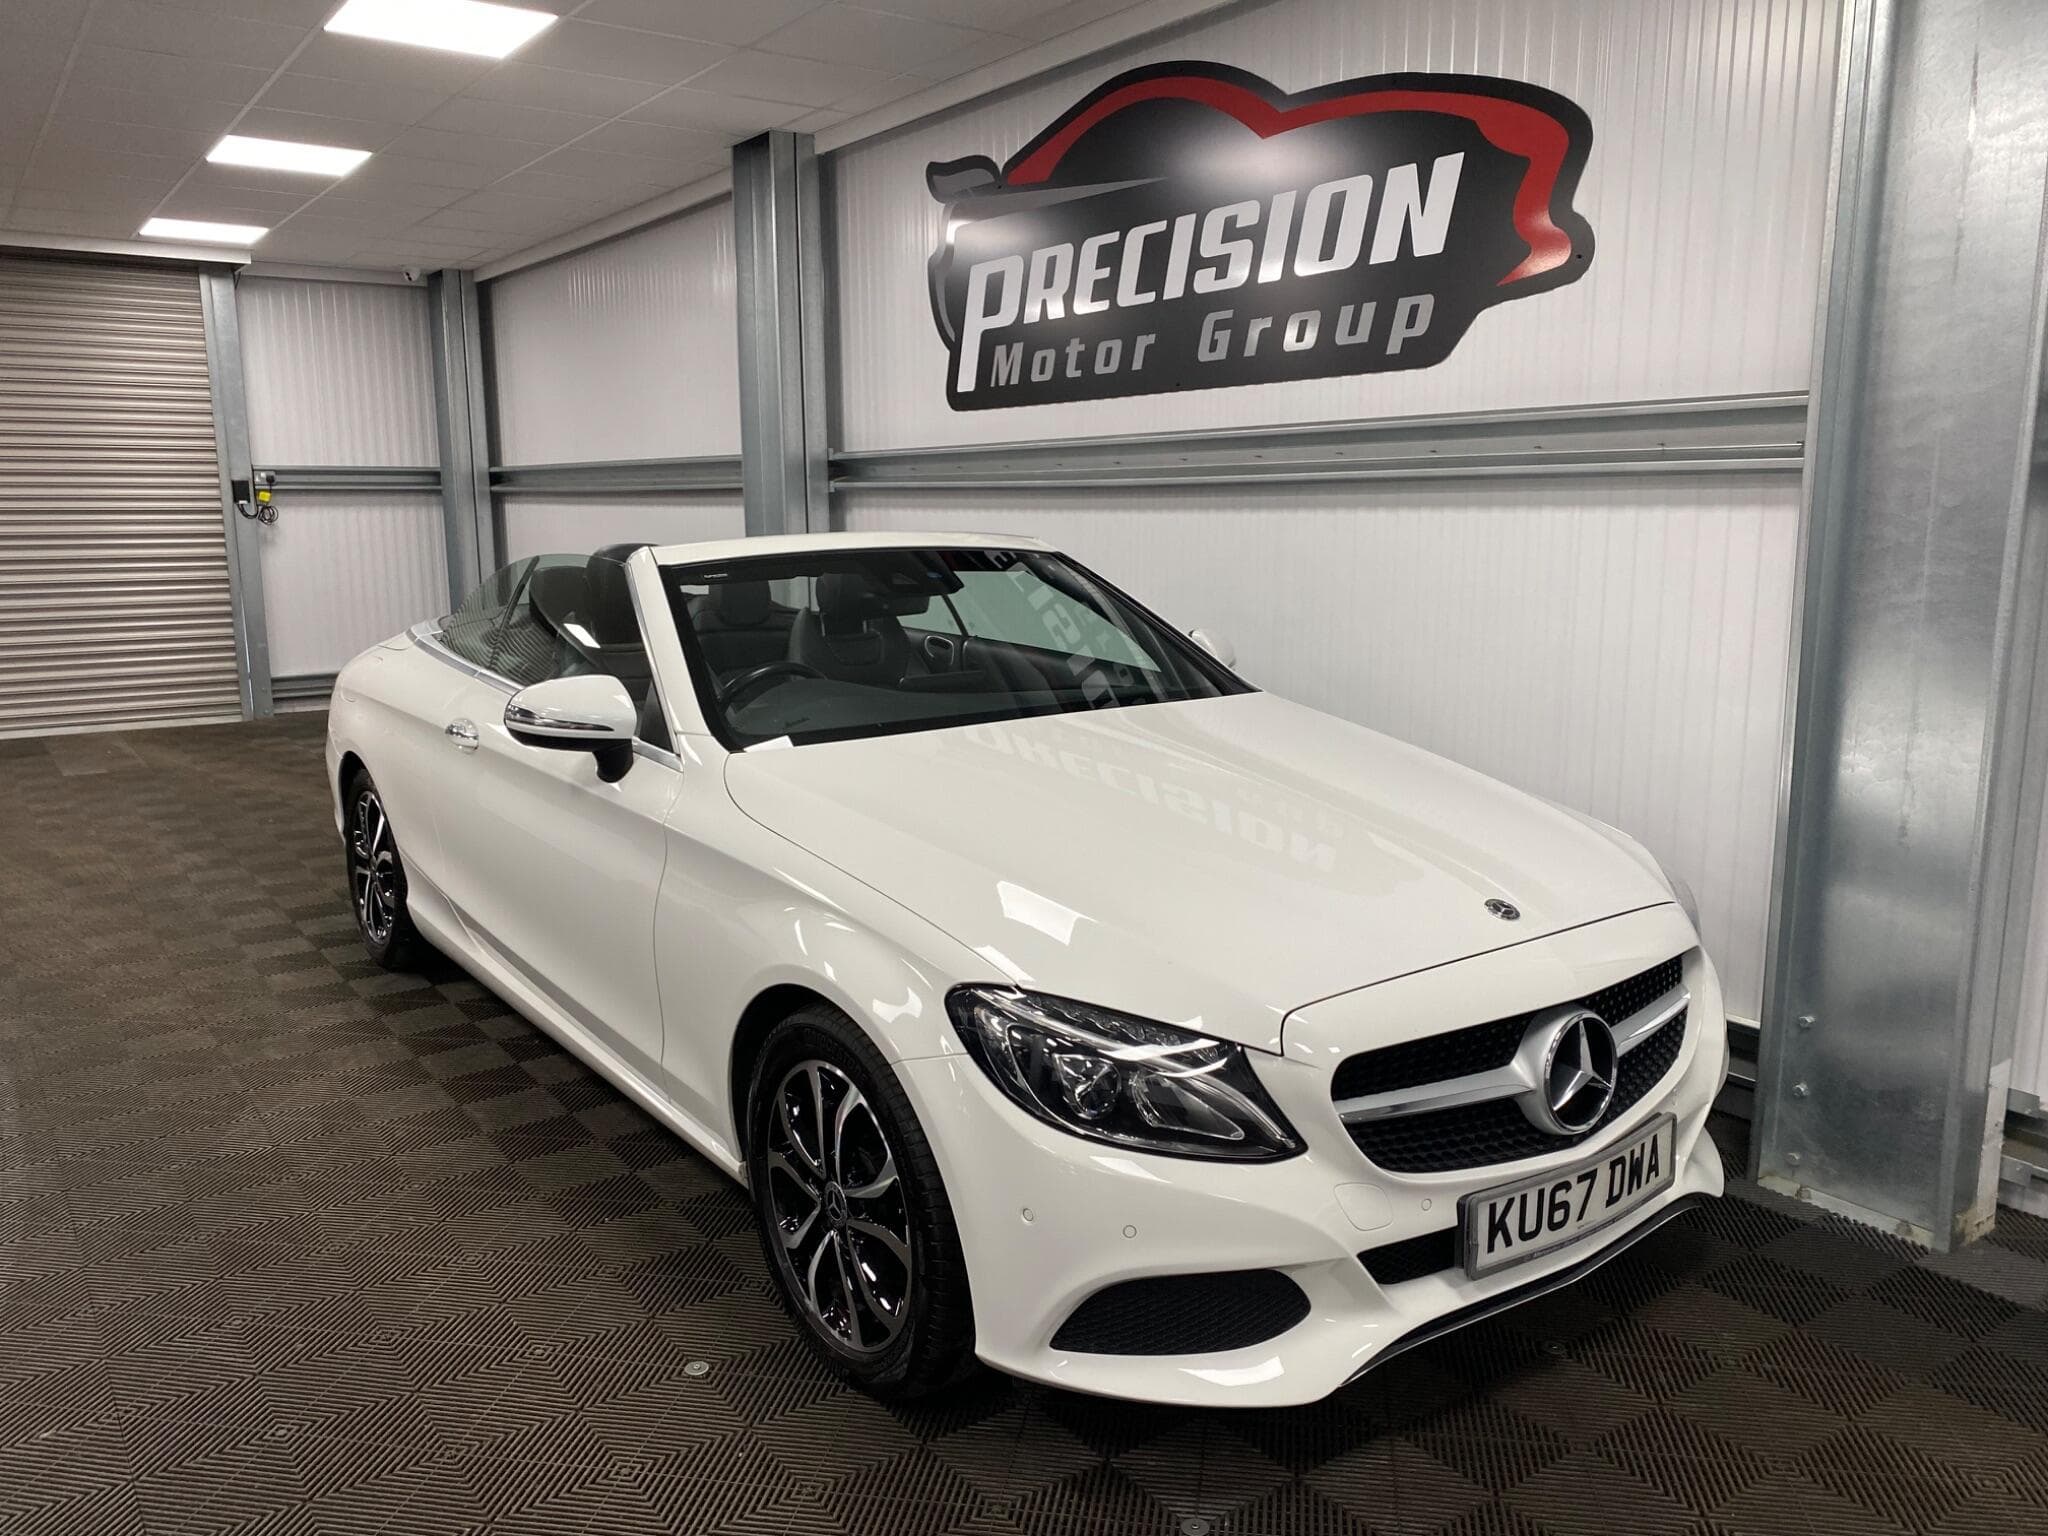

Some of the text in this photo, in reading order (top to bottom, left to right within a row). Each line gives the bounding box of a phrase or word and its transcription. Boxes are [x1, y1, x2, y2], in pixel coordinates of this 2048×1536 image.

[956, 151, 1464, 393] PRECISION
[991, 293, 1435, 388] Motor Group
[1486, 1133, 1660, 1255] KU67 DWA
